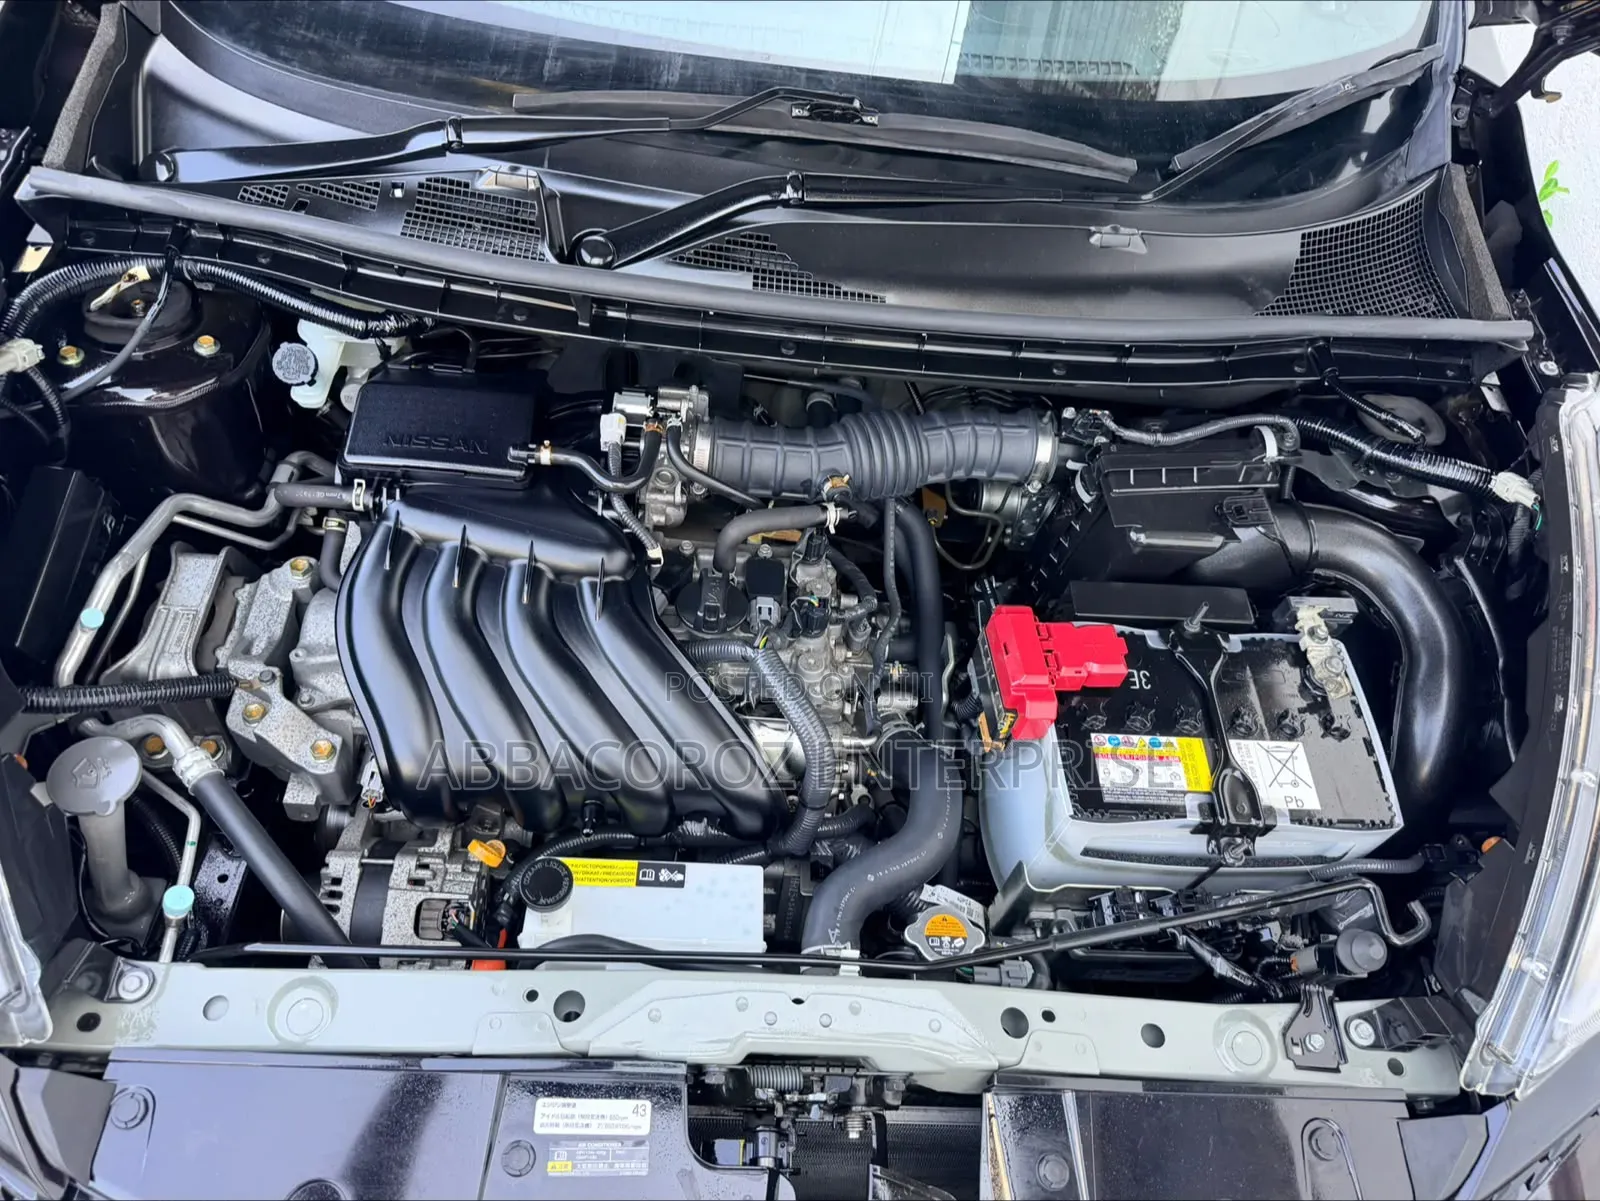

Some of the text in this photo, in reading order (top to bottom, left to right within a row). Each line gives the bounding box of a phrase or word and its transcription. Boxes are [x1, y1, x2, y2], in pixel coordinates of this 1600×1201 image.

[383, 434, 489, 455] NISSAN
[1284, 795, 1305, 808] Pb
[632, 1103, 647, 1117] 43
